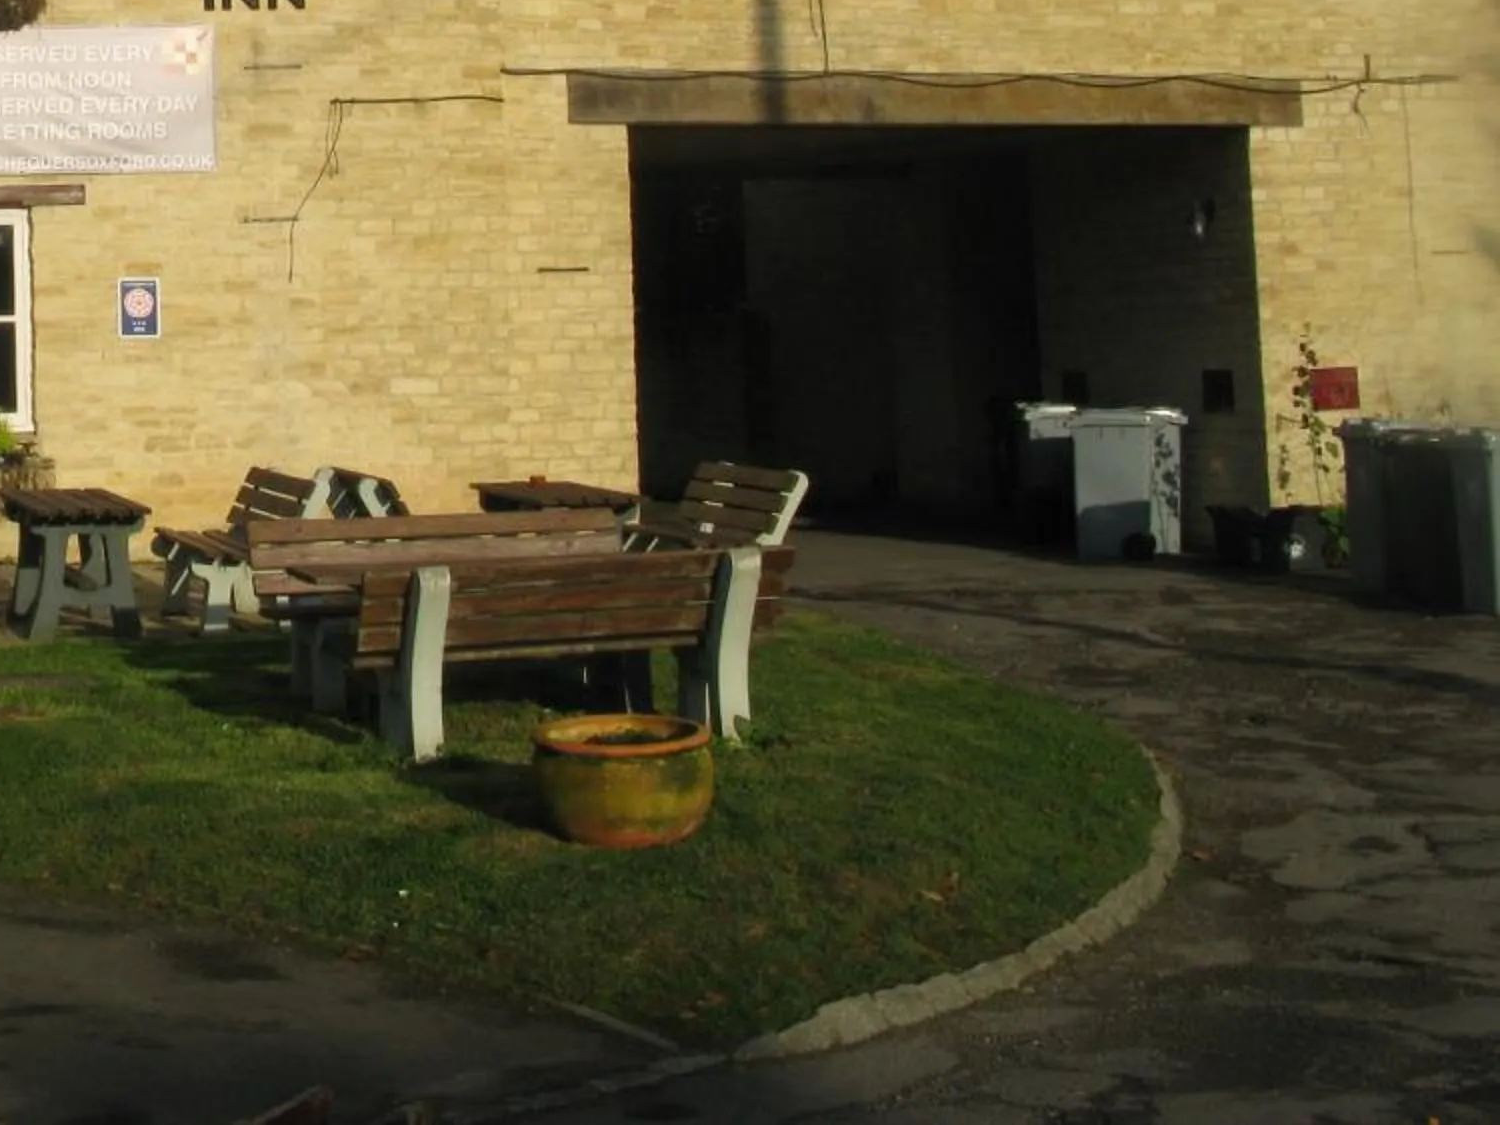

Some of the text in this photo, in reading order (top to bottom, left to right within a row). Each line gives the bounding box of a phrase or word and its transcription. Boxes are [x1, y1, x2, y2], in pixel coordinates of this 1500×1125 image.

[84, 43, 155, 62] EVERY
[1, 72, 63, 90] FROM
[67, 71, 133, 91] NOON
[80, 93, 150, 114] EVERY
[156, 93, 199, 114] DAY
[87, 121, 169, 141] ROOMS
